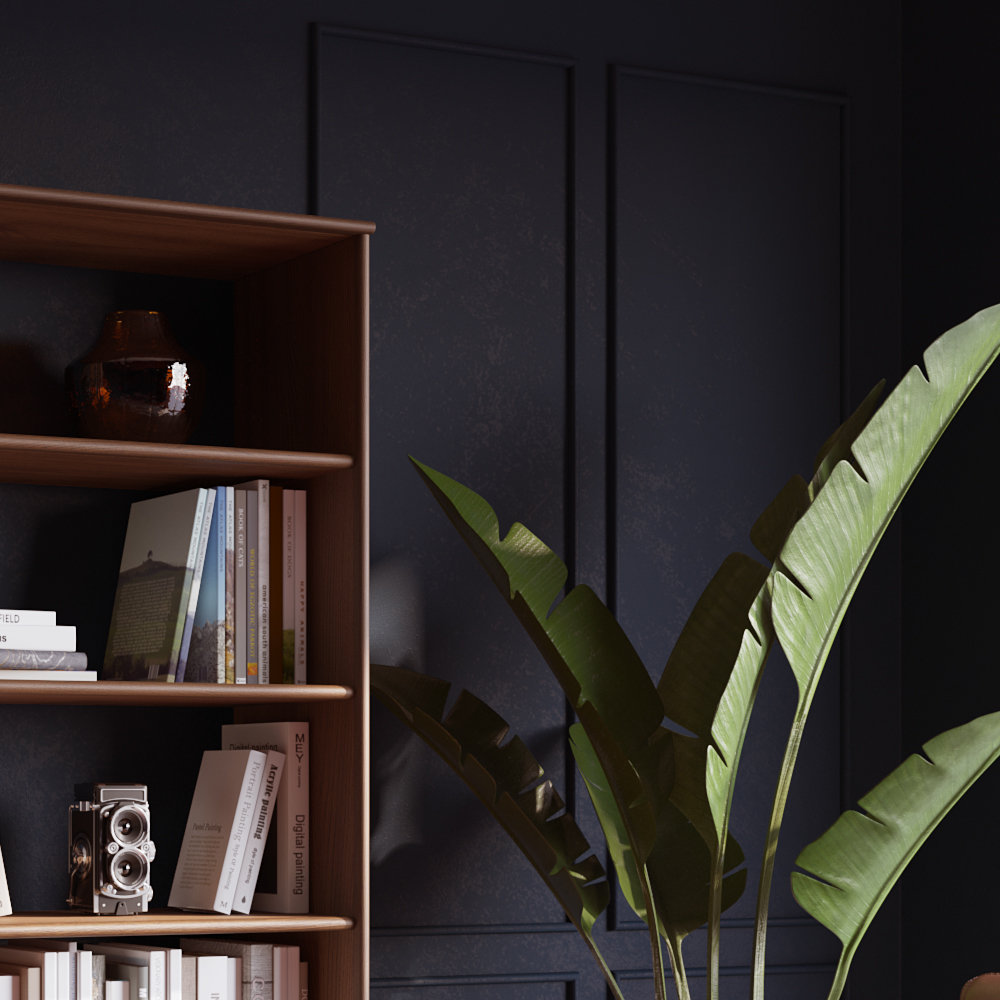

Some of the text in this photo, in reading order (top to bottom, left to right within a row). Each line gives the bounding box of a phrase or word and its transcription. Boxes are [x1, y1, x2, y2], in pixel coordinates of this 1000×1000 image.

[238, 534, 244, 545] OF
[287, 541, 292, 552] OF
[249, 578, 256, 588] OF
[233, 761, 261, 841] Portrait Painting
[254, 764, 278, 840] Acrylic painting
[293, 814, 305, 894] Digital painting
